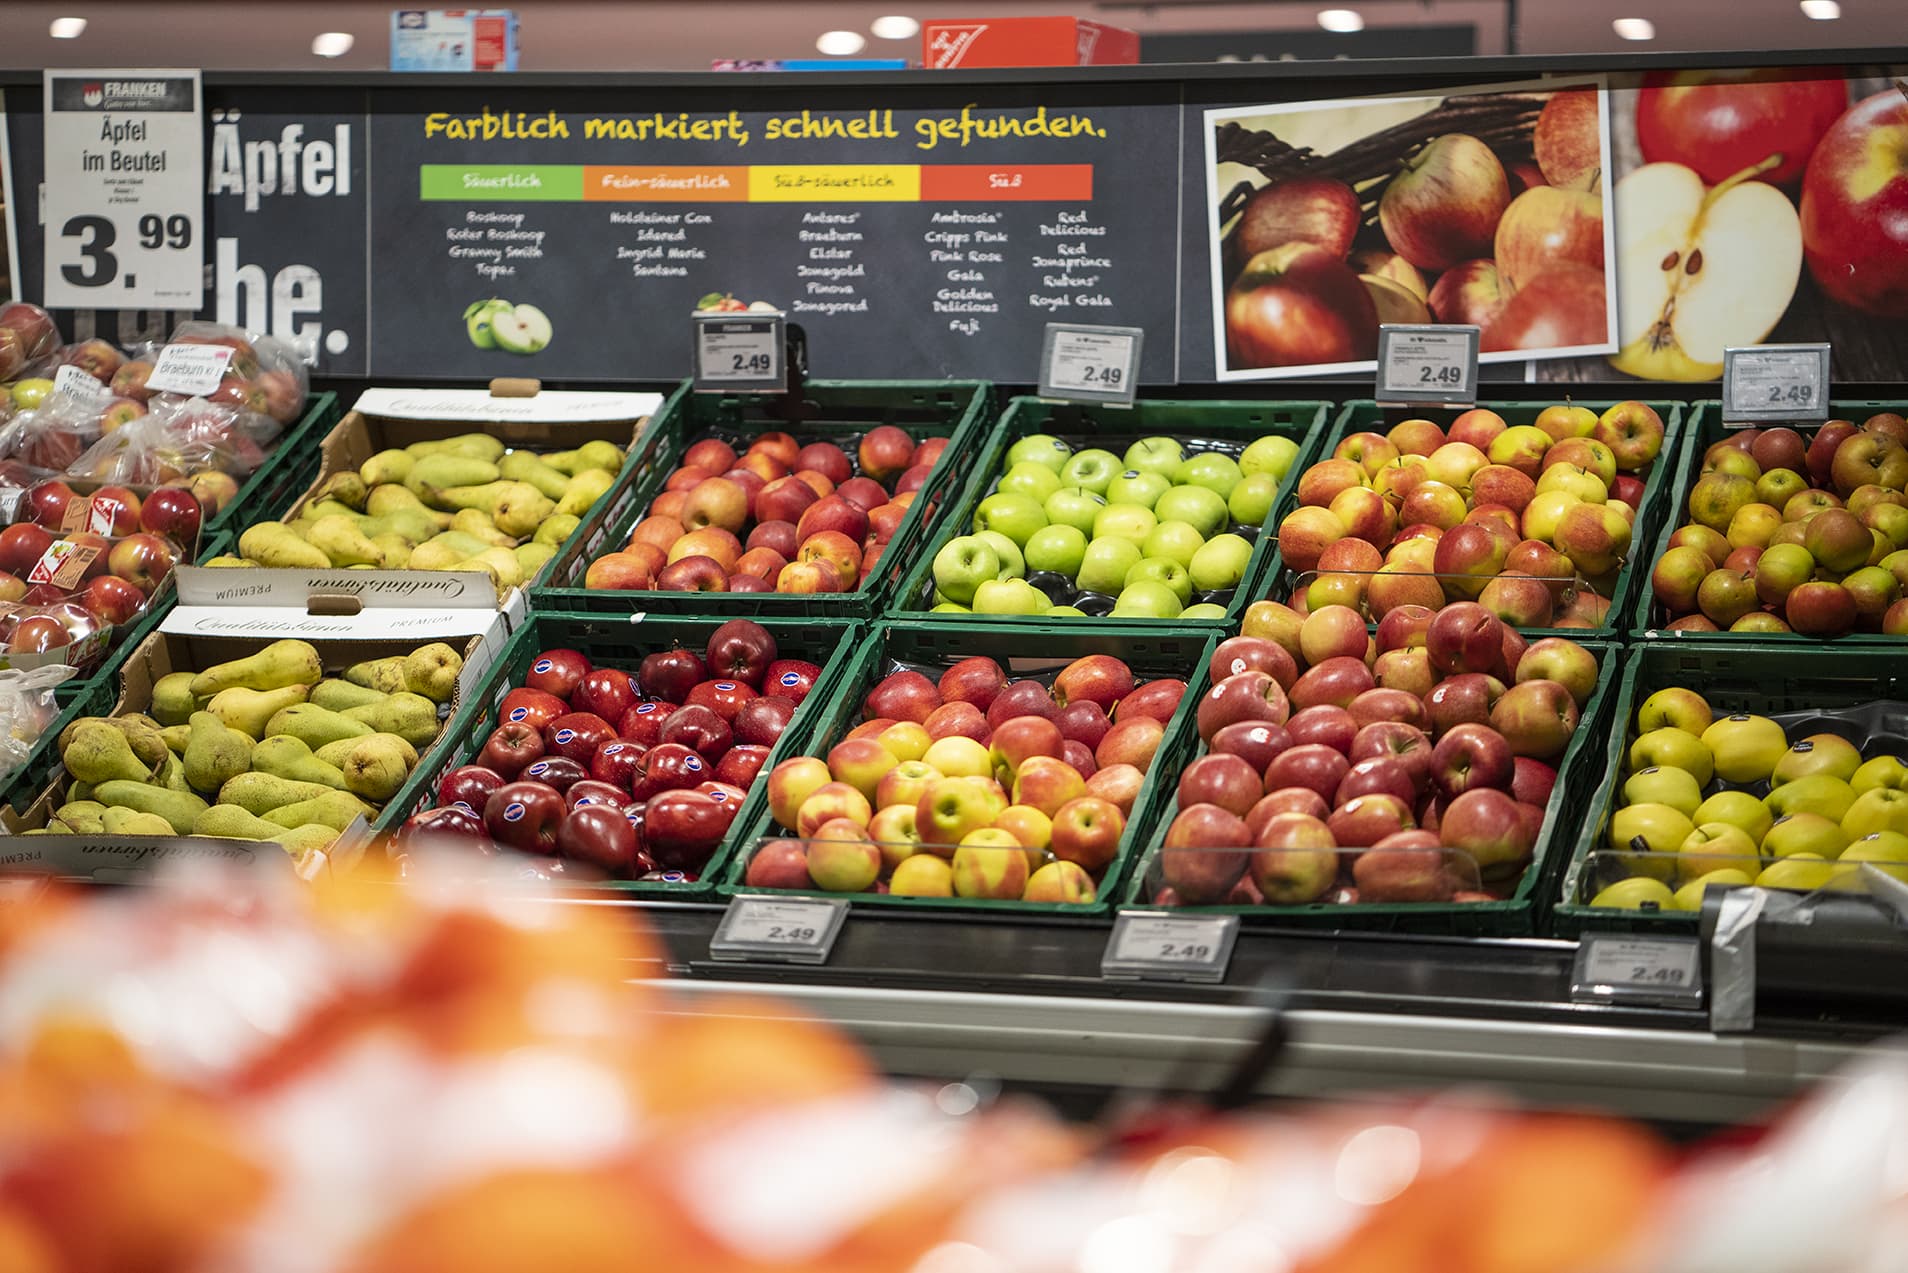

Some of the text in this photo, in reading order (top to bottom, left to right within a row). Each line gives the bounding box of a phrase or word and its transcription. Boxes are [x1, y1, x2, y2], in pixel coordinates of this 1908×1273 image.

[104, 82, 167, 97] FRANKEN
[101, 114, 147, 146] Äpfel
[424, 104, 1107, 150] Farblich markiert, schnell gefunden.
[83, 150, 167, 171] im Beutel
[208, 107, 351, 212] Äpfel
[462, 172, 542, 189] Säuerlich
[466, 211, 525, 229] Boskoop
[610, 211, 712, 224] Holsteiner Cox
[1057, 210, 1088, 224] Red
[487, 228, 546, 246] Boskoop
[637, 227, 687, 241] Idared
[799, 227, 864, 241] Braeburn
[1039, 224, 1107, 236] Delicious
[924, 230, 1008, 249] Cripps Pink
[448, 245, 502, 264] Granny
[616, 245, 664, 263] Ingrid
[930, 249, 1004, 262] Pink Rose
[1057, 242, 1088, 256] Red
[797, 263, 866, 281] Jonagold
[1032, 256, 1112, 273] Jonaprince
[947, 269, 985, 282] Gala
[806, 281, 854, 294] Pinova
[936, 287, 995, 300] Golden
[792, 298, 869, 316] Jonagored
[932, 300, 999, 312] Delicious
[1029, 293, 1113, 312] Royal Gala
[949, 318, 980, 336] Fuji
[733, 353, 771, 370] 2.49
[1083, 366, 1122, 383] 2.49
[1420, 366, 1461, 383] 2.49
[1768, 385, 1813, 403] 2.49
[215, 583, 272, 600] PREMIUM
[391, 615, 454, 629] PREMIUM
[0, 851, 42, 865] PREMI
[767, 926, 816, 940] 2.49
[1160, 943, 1210, 957] 2.49
[1630, 966, 1685, 981] 2.49
